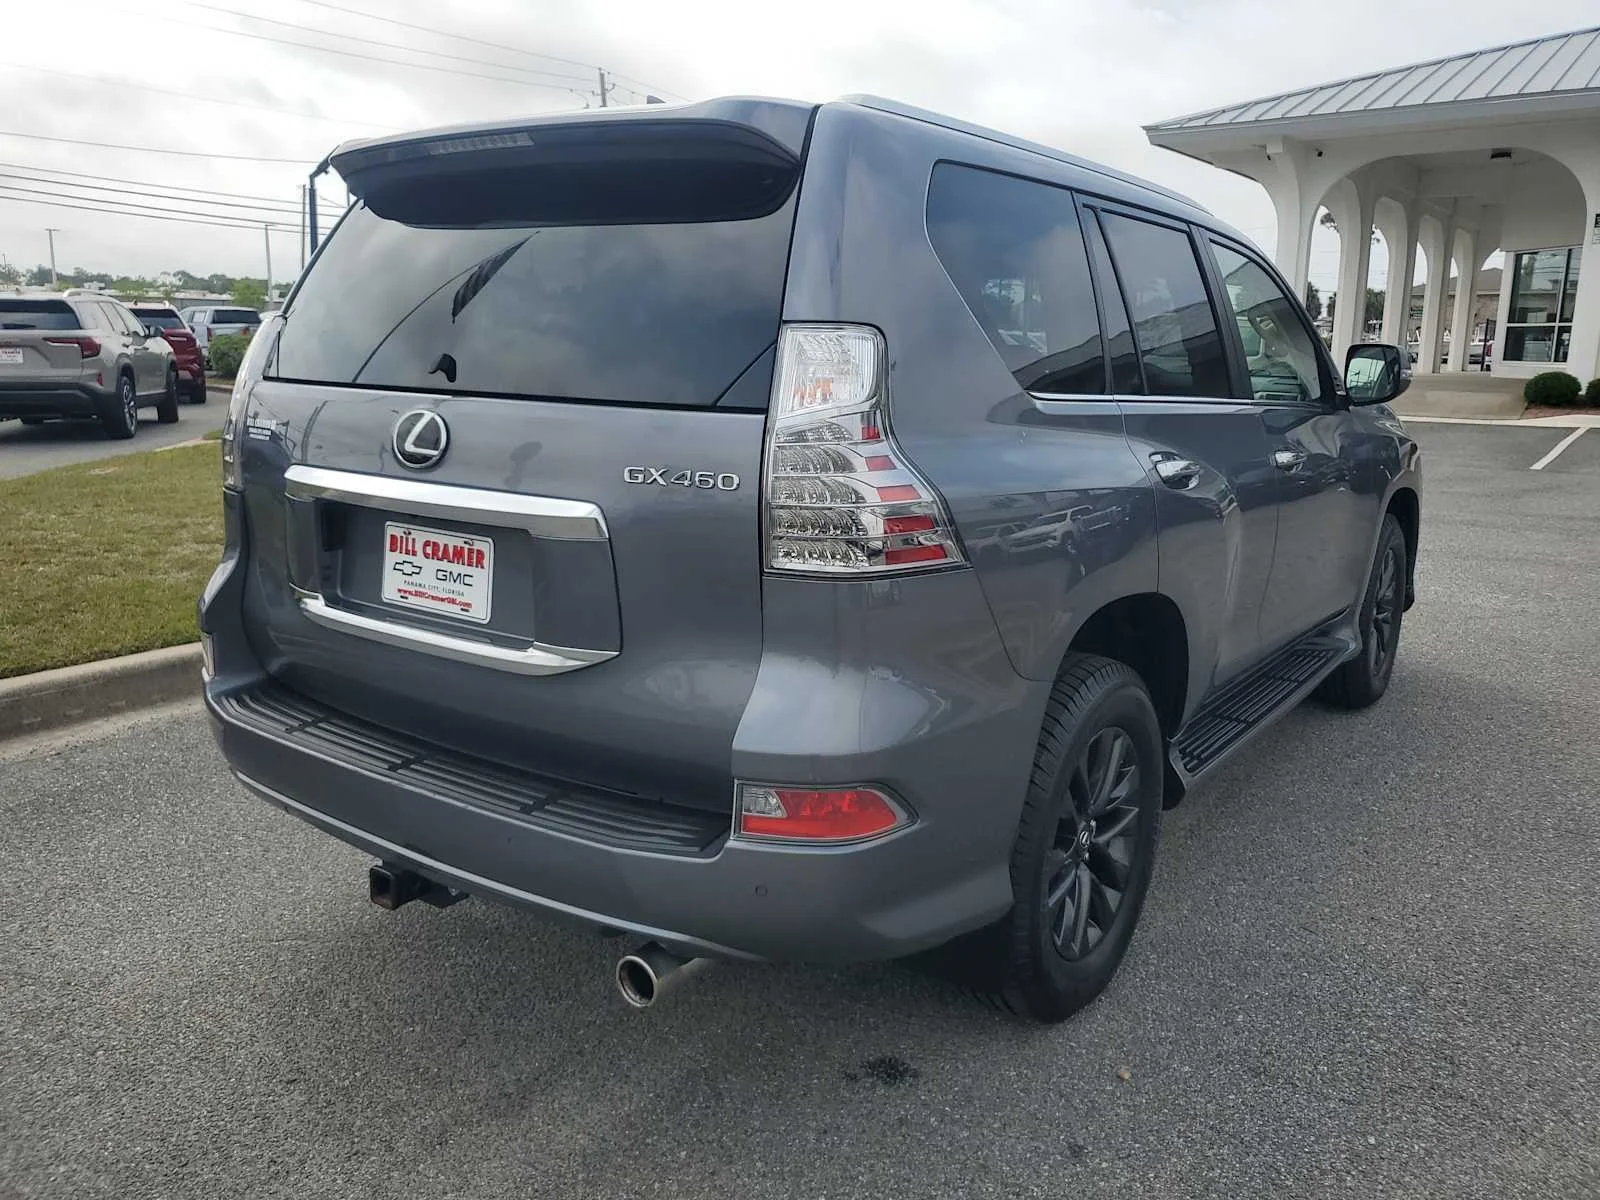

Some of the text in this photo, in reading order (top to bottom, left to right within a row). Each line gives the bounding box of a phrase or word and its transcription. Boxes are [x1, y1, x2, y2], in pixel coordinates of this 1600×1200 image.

[389, 534, 486, 569] BILL CRAMER
[436, 568, 474, 587] GMC
[404, 580, 426, 589] PANAMA
[442, 587, 465, 597] FLORIDA
